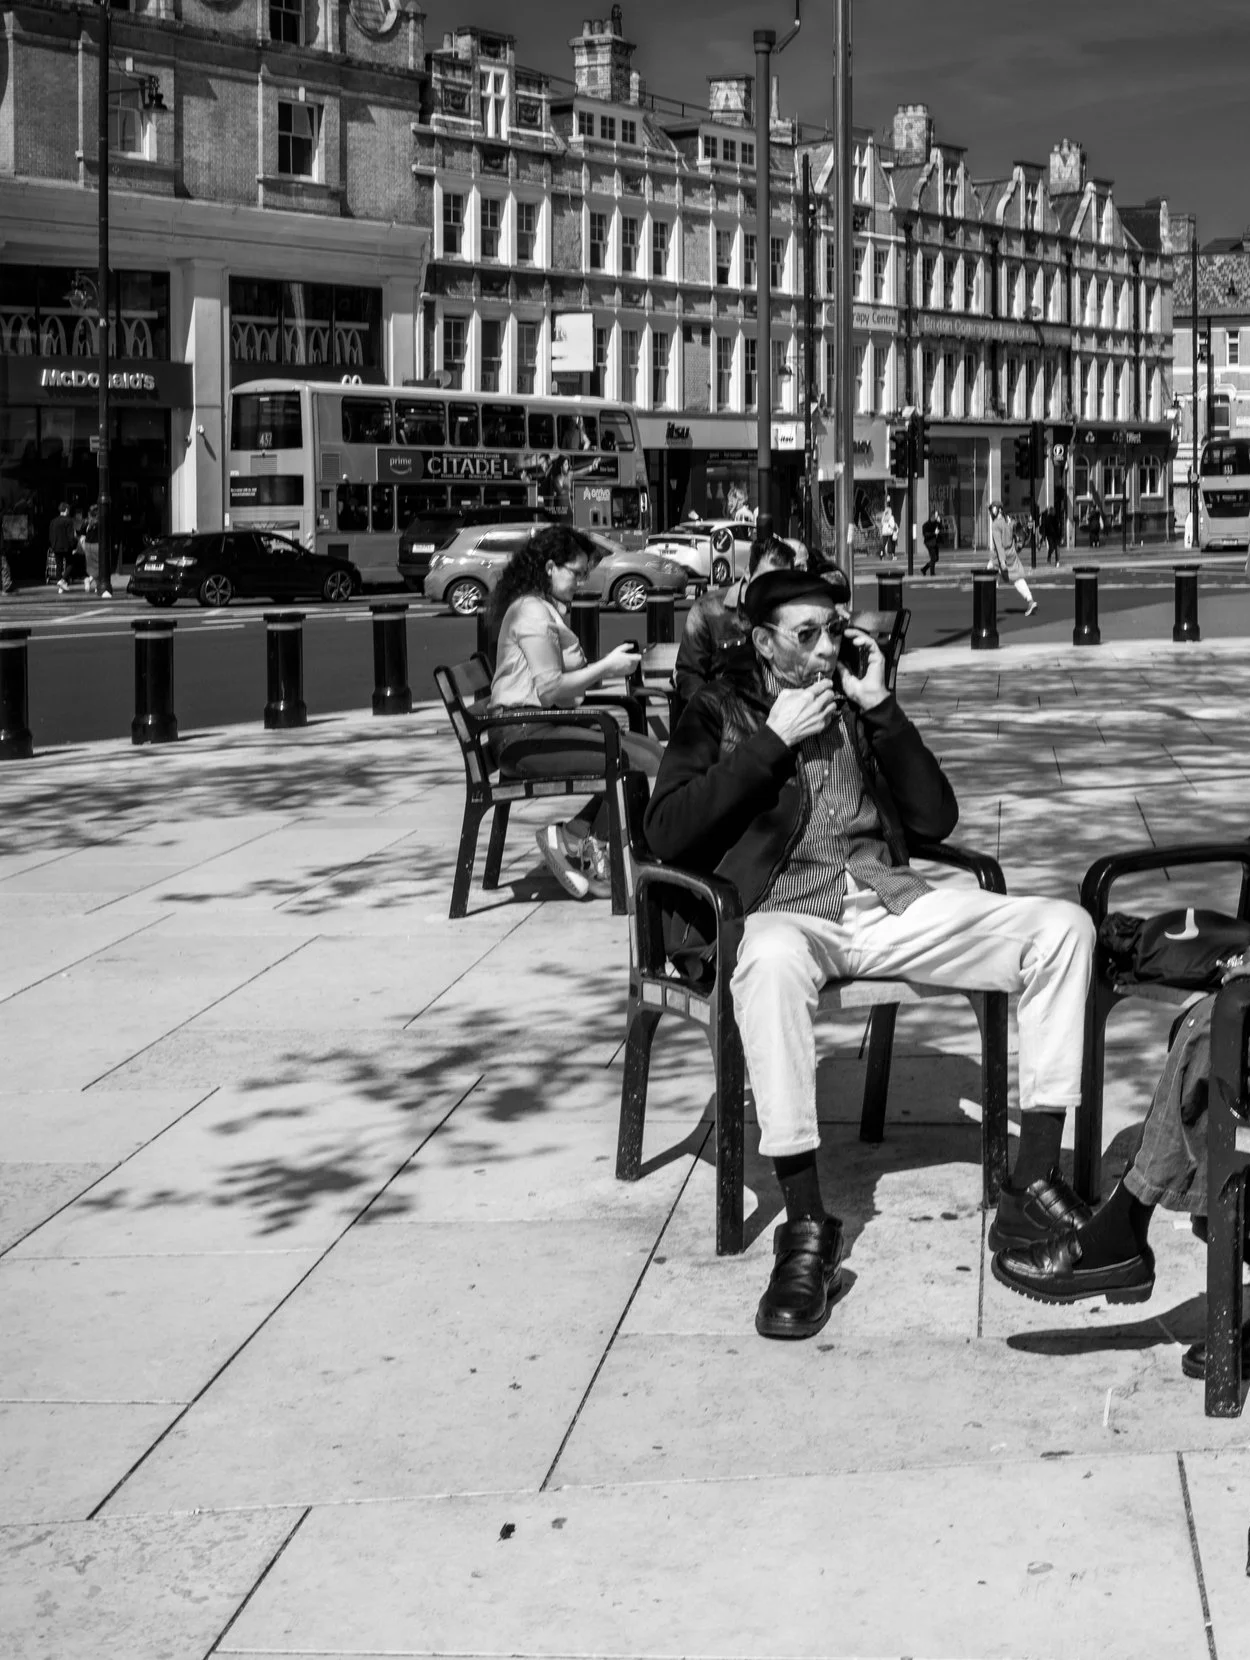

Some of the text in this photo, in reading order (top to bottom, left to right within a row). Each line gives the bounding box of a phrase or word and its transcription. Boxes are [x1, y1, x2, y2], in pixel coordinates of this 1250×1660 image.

[872, 312, 896, 325] Centre
[924, 315, 952, 331] Brixton
[41, 369, 155, 390] McDoald's
[666, 421, 690, 439] itsu
[389, 455, 412, 467] prime
[427, 456, 514, 476] CITADEL
